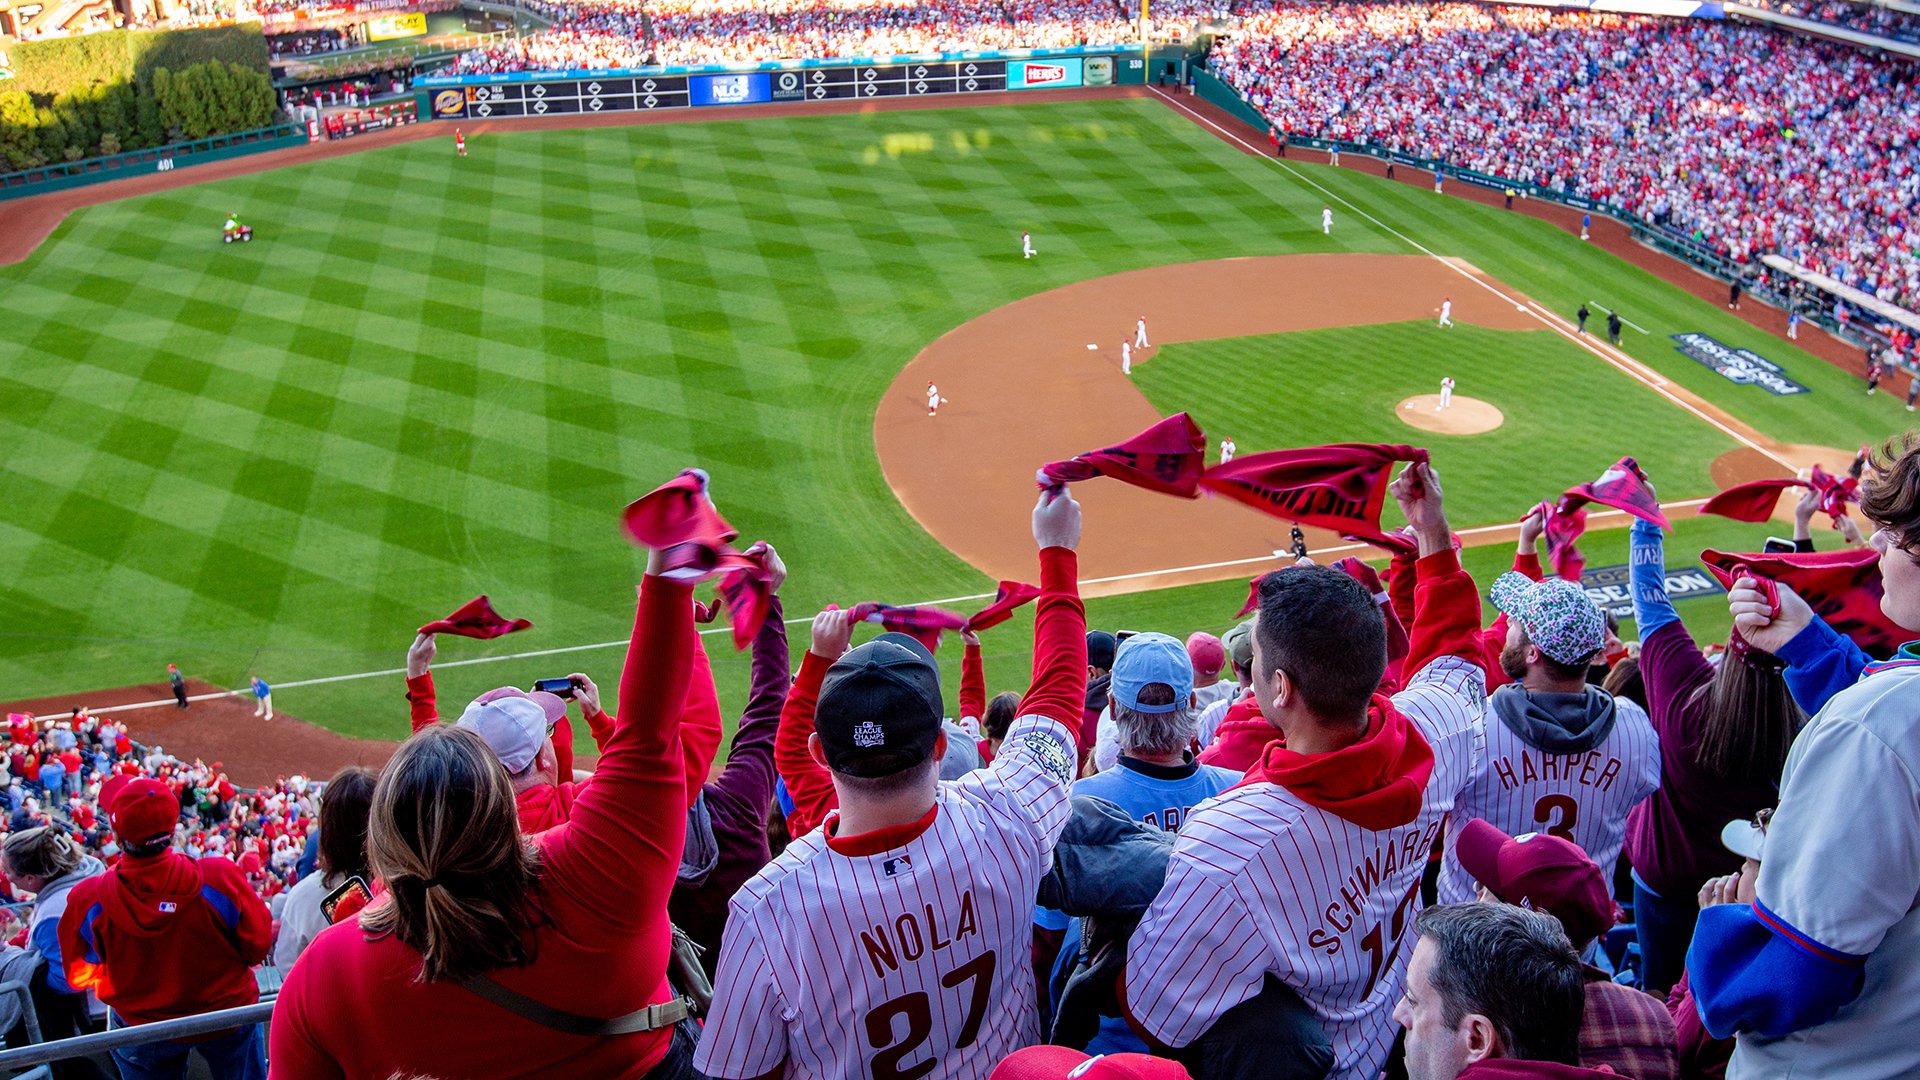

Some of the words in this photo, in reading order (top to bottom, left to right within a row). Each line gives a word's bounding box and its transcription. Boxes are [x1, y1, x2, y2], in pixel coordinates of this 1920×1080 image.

[712, 83, 750, 98] NLCS
[157, 158, 174, 171] 401
[853, 733, 885, 741] CHAMPS
[855, 727, 882, 735] LEAGUE
[1492, 750, 1622, 792] HARPER
[1533, 793, 1578, 843] 3
[860, 889, 977, 979] NOLA
[864, 949, 997, 1080] 27
